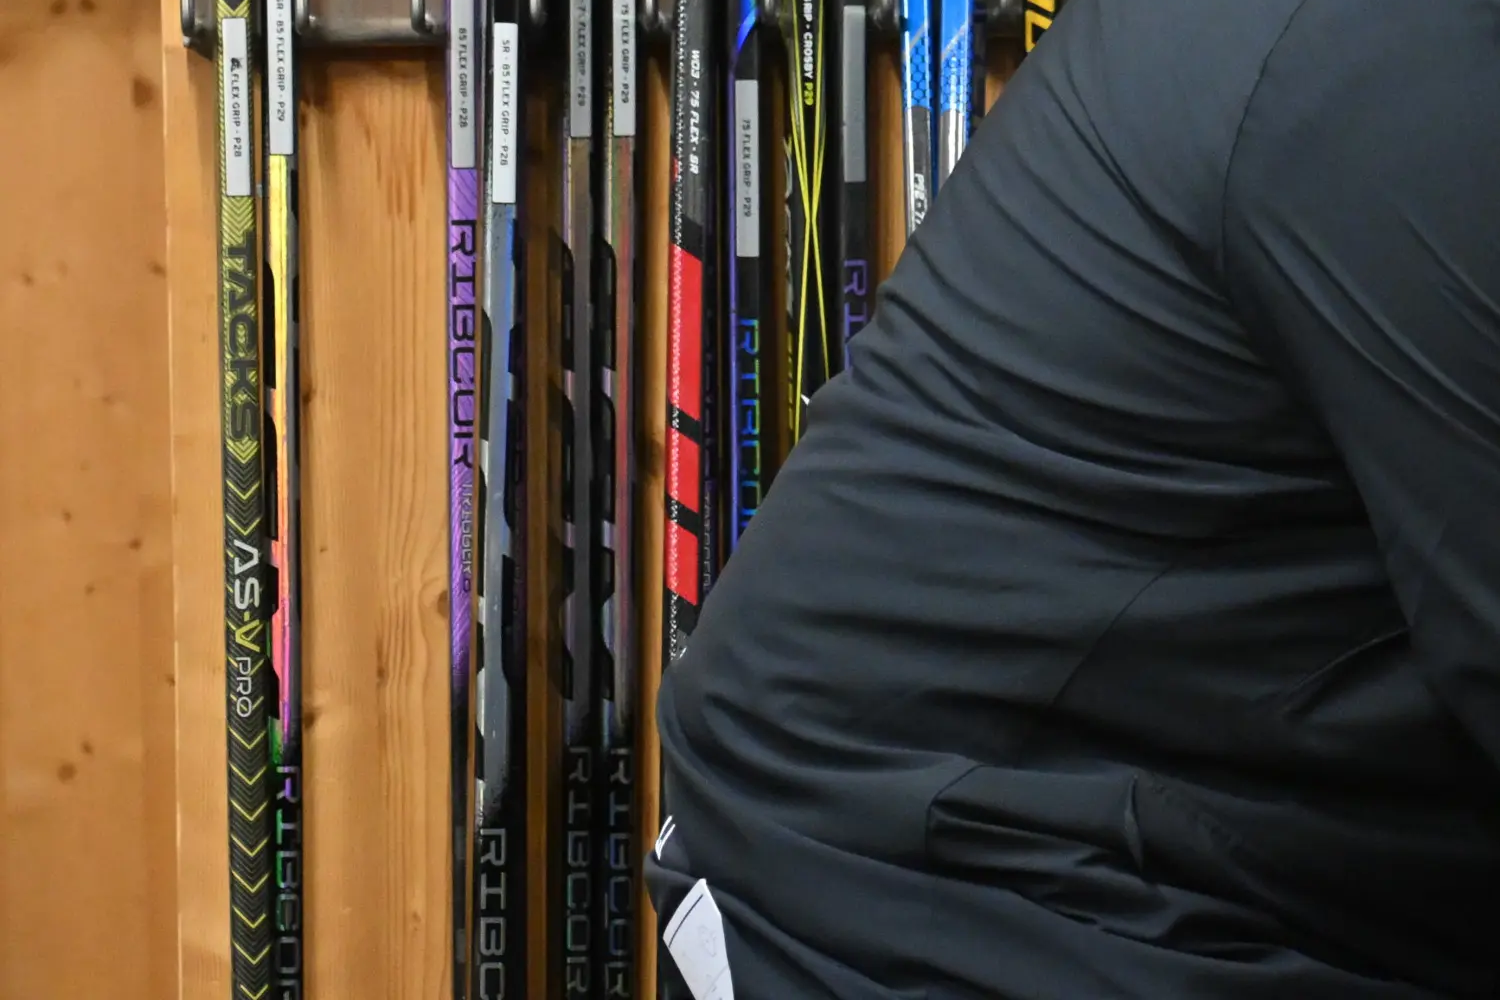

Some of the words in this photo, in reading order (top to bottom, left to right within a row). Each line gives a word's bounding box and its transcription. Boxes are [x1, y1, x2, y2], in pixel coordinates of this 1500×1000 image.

[276, 20, 285, 34] 85
[458, 27, 467, 41] 85
[577, 22, 586, 48] FLEX
[621, 19, 630, 45] FLEX
[276, 37, 285, 64] FLEX
[458, 44, 467, 69] FLEX
[502, 39, 511, 53] SR
[803, 31, 814, 79] CROSBY
[502, 63, 511, 77] 85
[577, 51, 586, 76] GRIP
[621, 48, 630, 73] GRIP
[231, 73, 240, 99] FLEX
[276, 66, 286, 92] GRIP
[459, 73, 468, 98] GRIP
[502, 80, 511, 107] FLEX
[577, 85, 586, 107] P29
[621, 83, 630, 104] P29
[690, 90, 700, 108] 75
[804, 82, 814, 106] P29
[232, 102, 241, 127] GRIP
[277, 102, 286, 122] P29
[459, 107, 468, 128] P28
[501, 110, 510, 136] GRIP
[690, 110, 700, 144] FLEX
[742, 119, 751, 131] 75
[233, 137, 242, 158] P28
[499, 145, 509, 166] P28
[742, 133, 751, 159] FLEX
[689, 154, 699, 175] SR
[743, 162, 752, 187] GRIP
[743, 197, 752, 218] P29
[843, 259, 867, 372] RI
[227, 232, 260, 441] TACKS
[451, 219, 476, 469] RIBCOR
[736, 317, 760, 540] RIBCO
[232, 539, 261, 652] AS-V
[235, 655, 254, 718] PRO
[566, 745, 592, 994] RIBCOR
[606, 746, 633, 1000] RIBCOR
[478, 827, 507, 1000] RIBC
